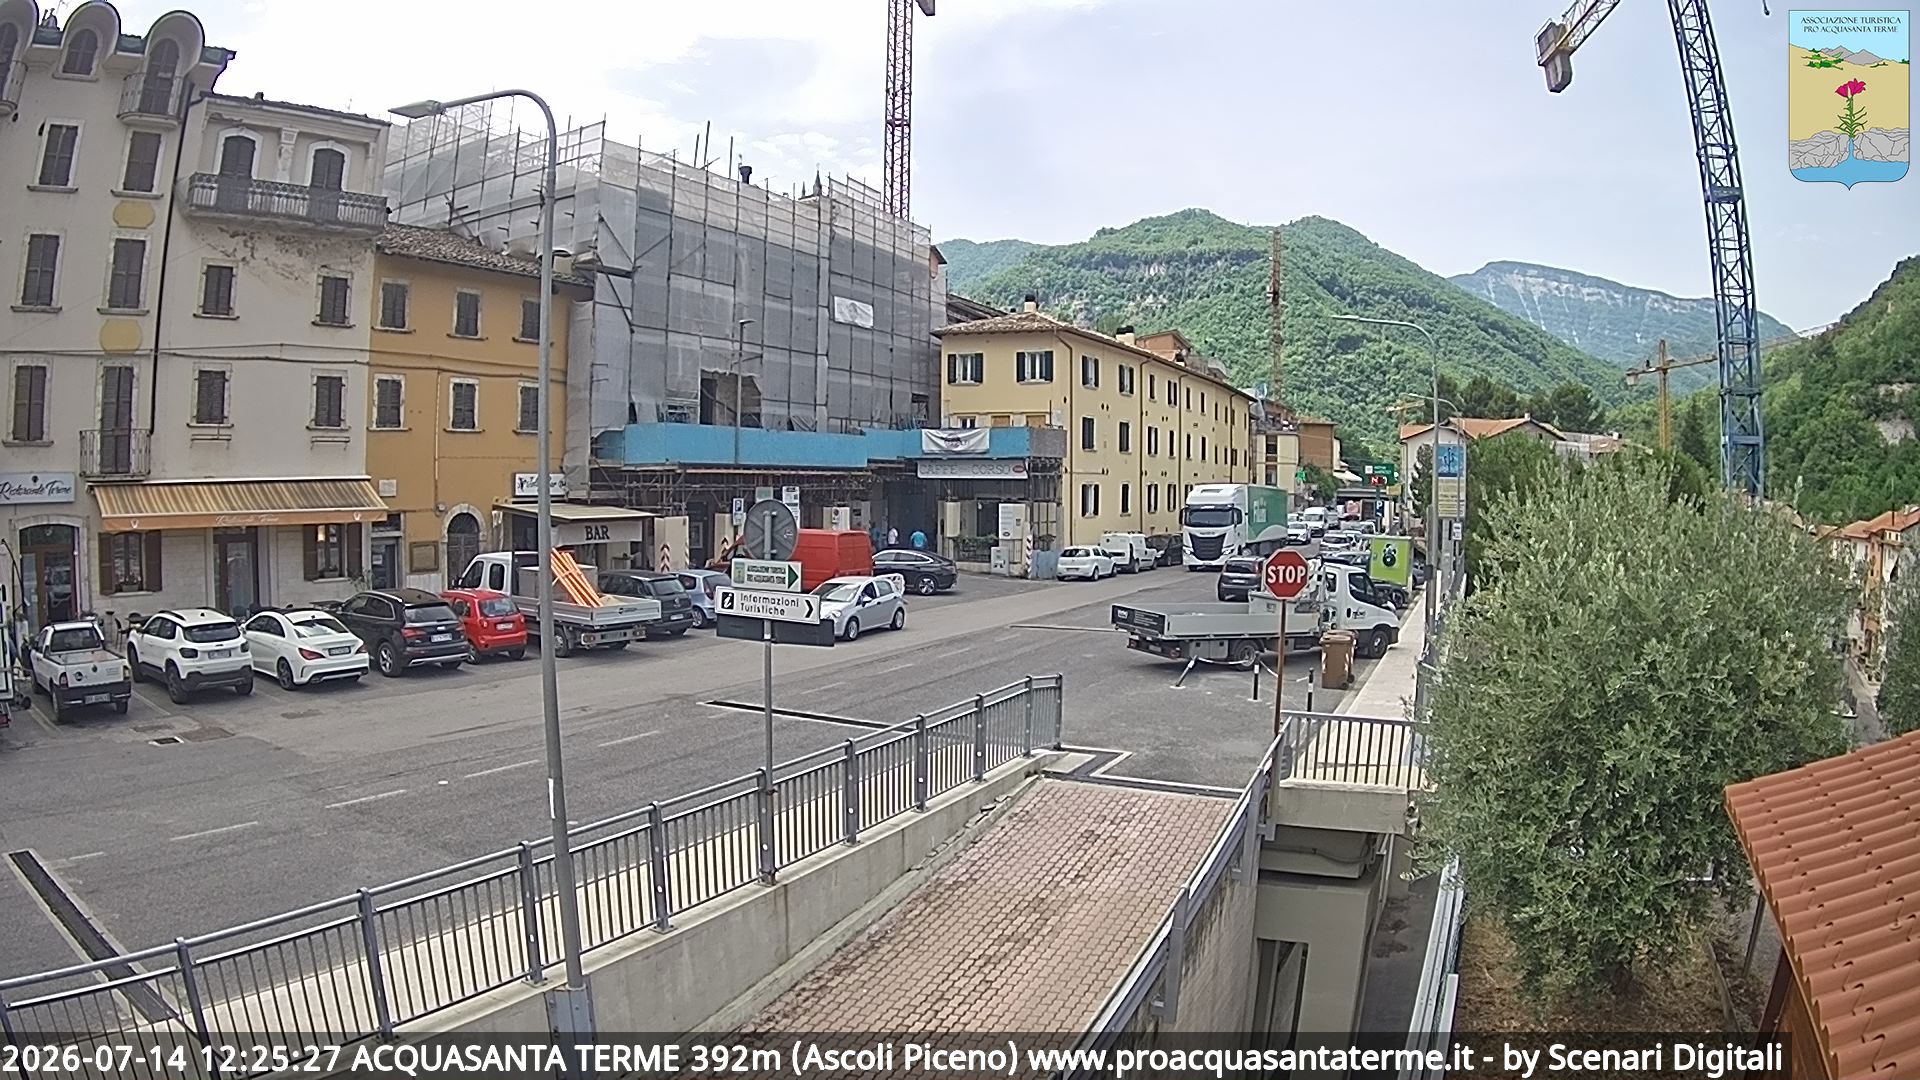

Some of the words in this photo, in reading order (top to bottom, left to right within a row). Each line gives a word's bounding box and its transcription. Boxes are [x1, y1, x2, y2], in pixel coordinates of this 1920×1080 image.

[585, 525, 610, 541] BAR
[1267, 565, 1307, 584] STOP
[740, 593, 800, 608] Informazioni
[740, 602, 786, 616] Turistiche
